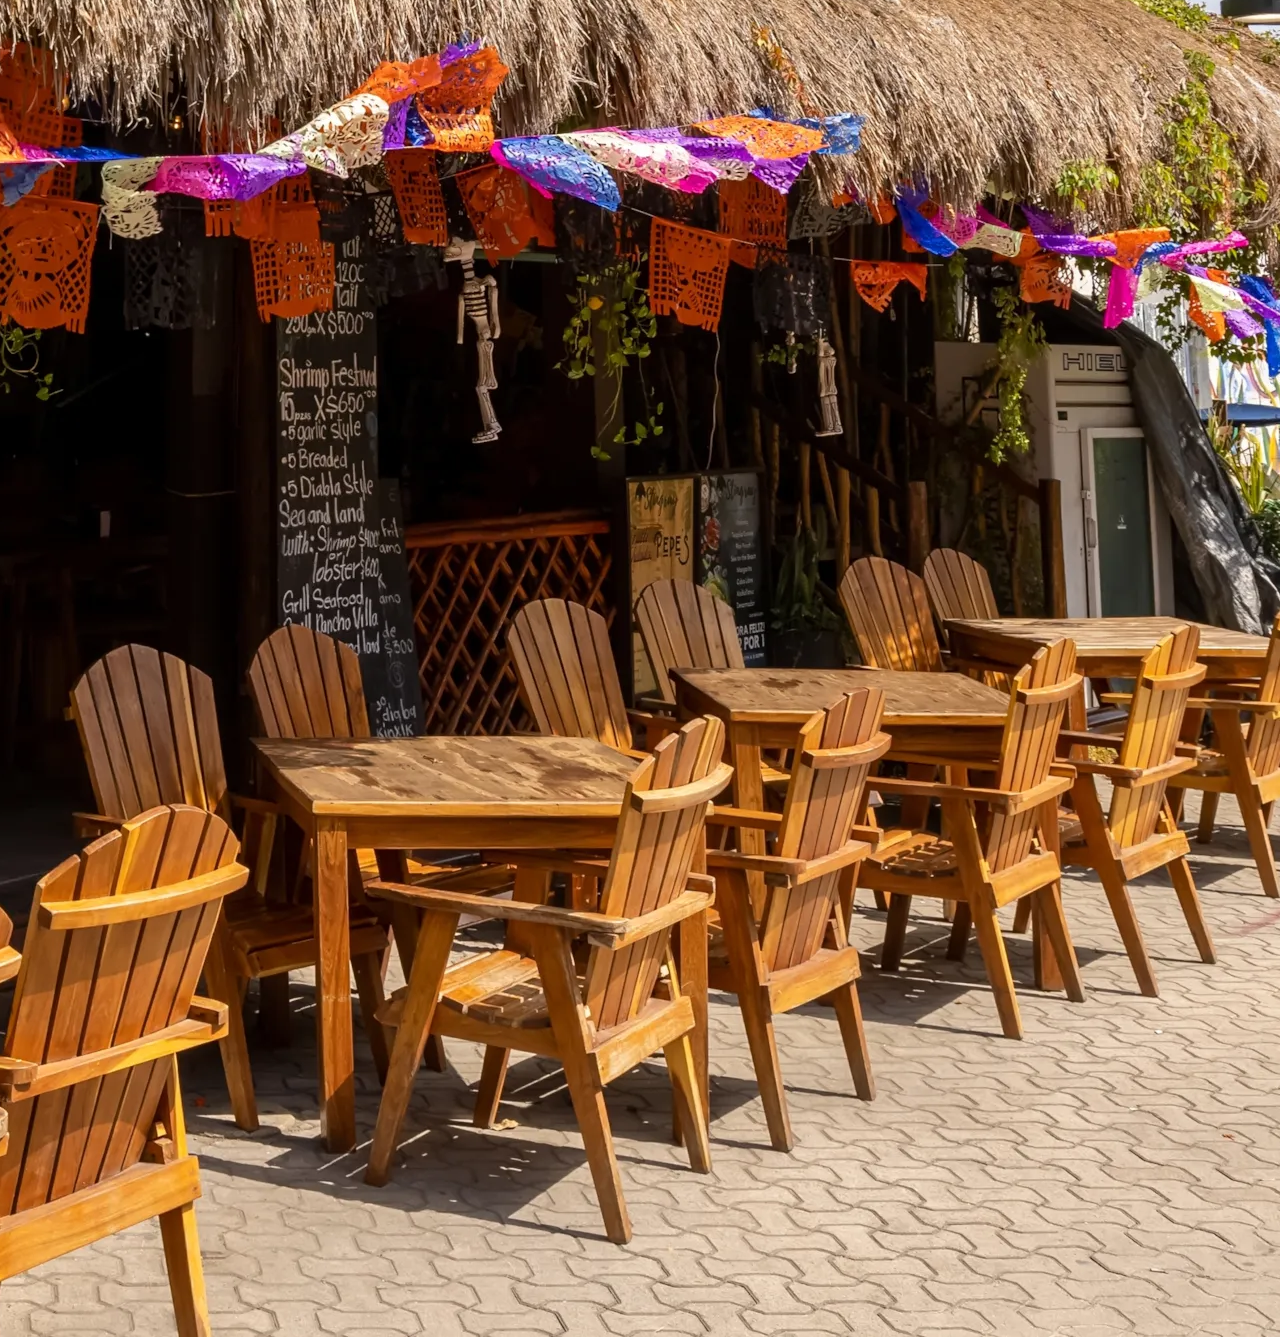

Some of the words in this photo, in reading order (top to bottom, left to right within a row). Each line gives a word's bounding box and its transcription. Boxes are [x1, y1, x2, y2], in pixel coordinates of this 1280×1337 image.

[280, 357, 329, 396] Shrimp
[1062, 352, 1128, 372] HIEL
[297, 419, 327, 446] garlic
[298, 446, 347, 468] Breaded
[300, 471, 341, 498] Diabla
[279, 499, 306, 528] Sea
[307, 502, 331, 524] and
[334, 497, 365, 523] land
[317, 525, 357, 557] Shrimp
[312, 552, 360, 583] lobster
[329, 551, 342, 561] or
[283, 583, 310, 613] Grill
[313, 582, 364, 609] Seafood
